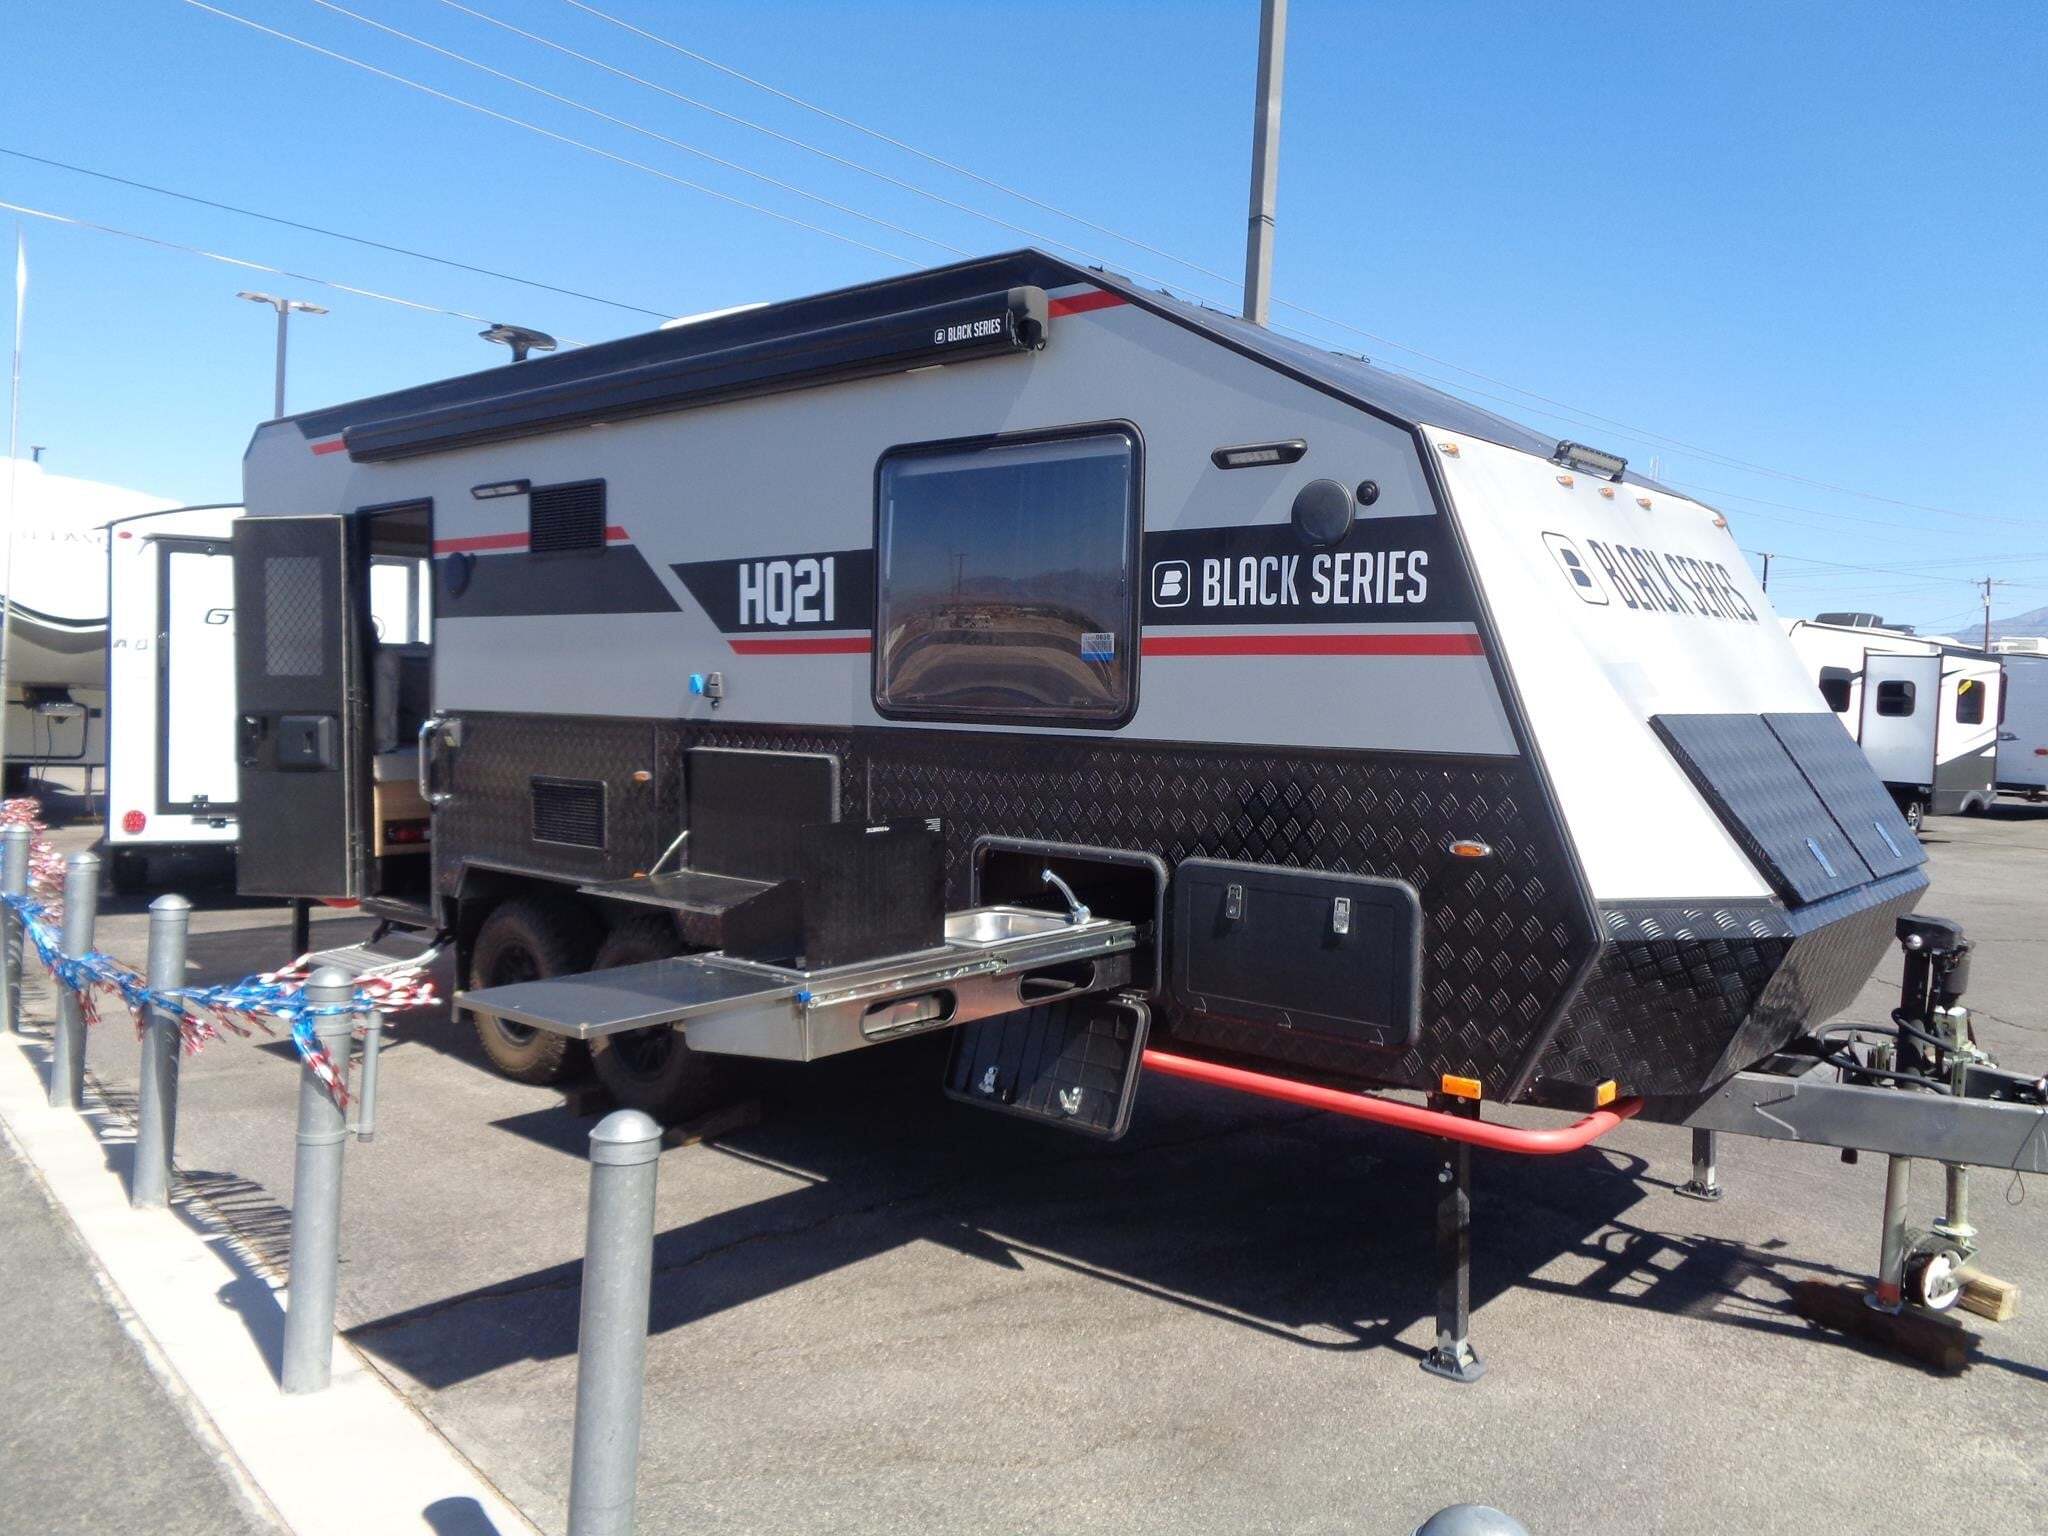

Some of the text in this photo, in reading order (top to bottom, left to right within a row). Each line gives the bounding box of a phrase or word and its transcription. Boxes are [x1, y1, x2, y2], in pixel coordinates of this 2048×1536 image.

[947, 322, 973, 341] BLACK
[973, 318, 1001, 337] SERIES
[739, 556, 834, 625] HQ21
[1202, 554, 1300, 607] BLACK
[1311, 550, 1429, 605] SERIES
[1586, 538, 1696, 615] BLACK
[1663, 552, 1759, 622] SERIES
